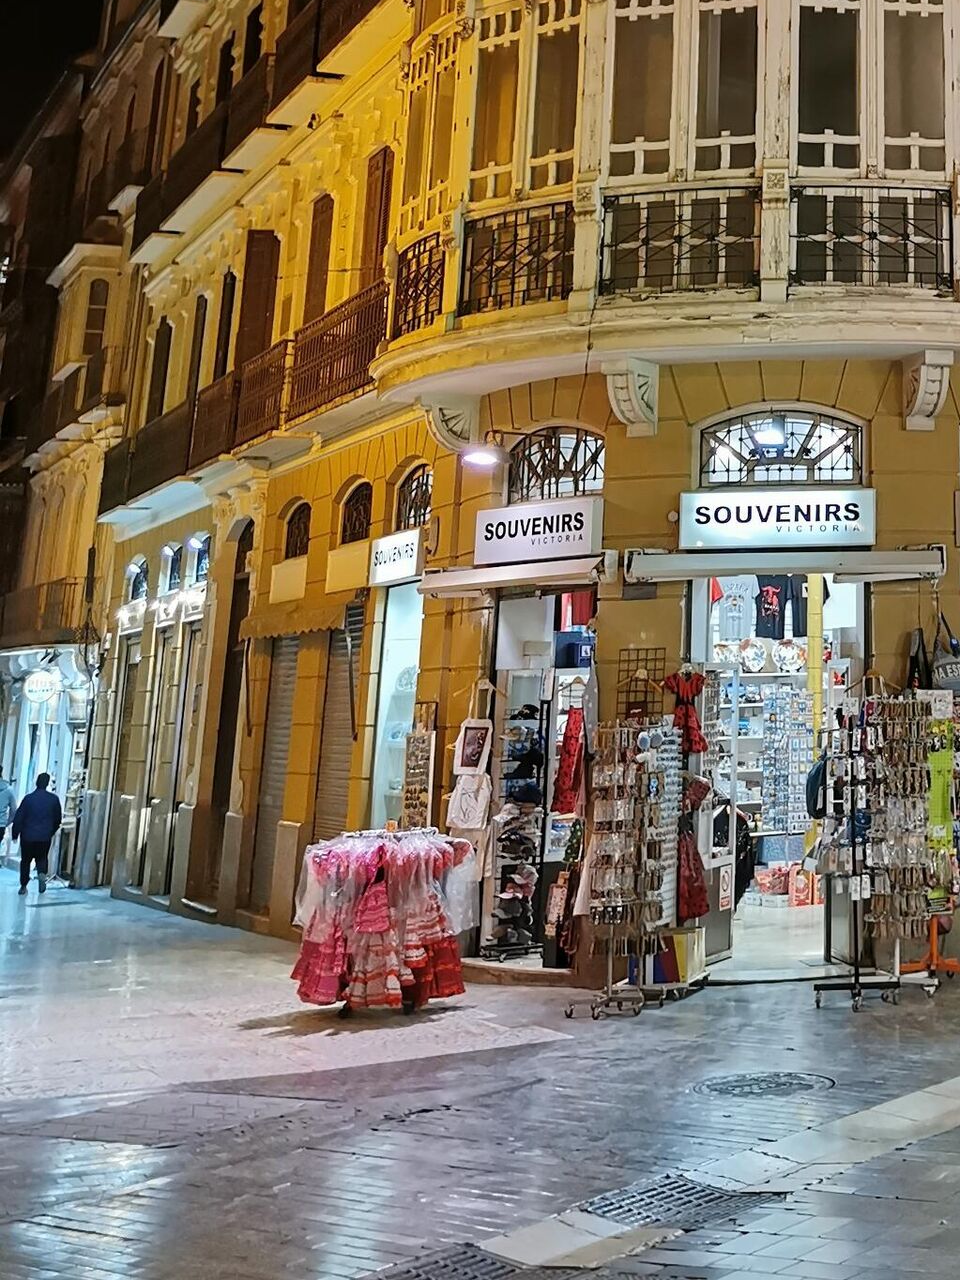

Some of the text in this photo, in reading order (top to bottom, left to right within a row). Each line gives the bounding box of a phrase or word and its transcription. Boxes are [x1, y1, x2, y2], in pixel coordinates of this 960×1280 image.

[695, 502, 860, 525] SOUVENIRS
[484, 512, 584, 541] SOUVENIRS
[776, 524, 861, 533] VICTORIA
[530, 533, 583, 545] VICTORIA
[374, 542, 414, 567] SOUVENIRS
